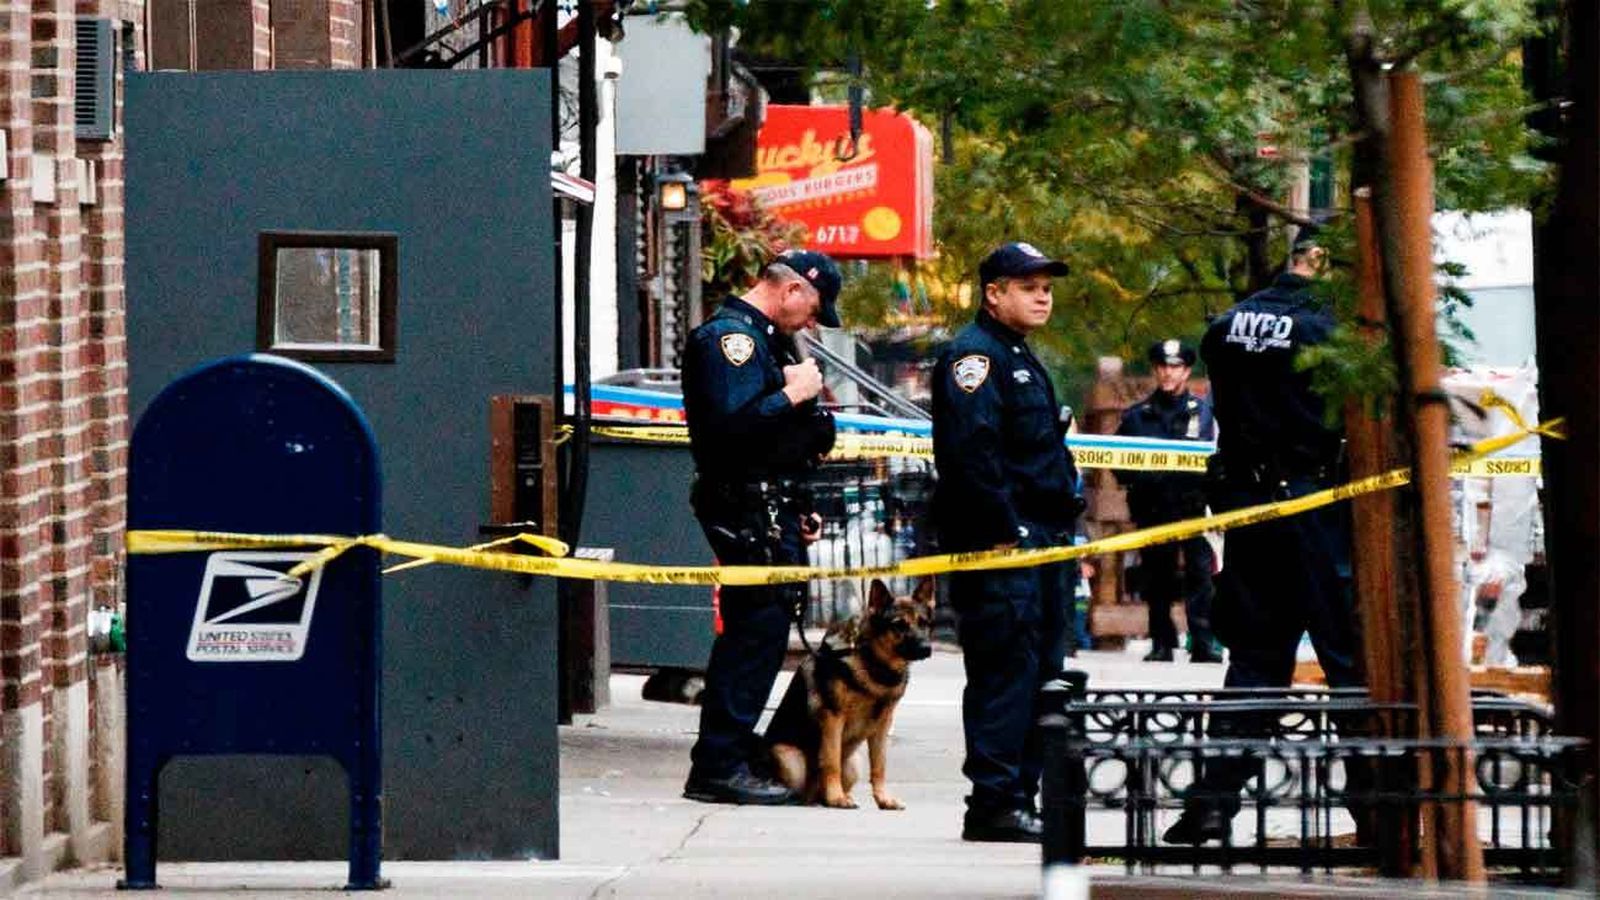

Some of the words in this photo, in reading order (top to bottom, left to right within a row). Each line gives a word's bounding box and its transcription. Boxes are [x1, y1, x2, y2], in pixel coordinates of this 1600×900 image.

[756, 129, 876, 178] ucky's
[1230, 311, 1293, 340] NYPD
[1119, 452, 1147, 465] NOT
[1486, 461, 1530, 474] CROSS
[198, 631, 248, 642] UNITED
